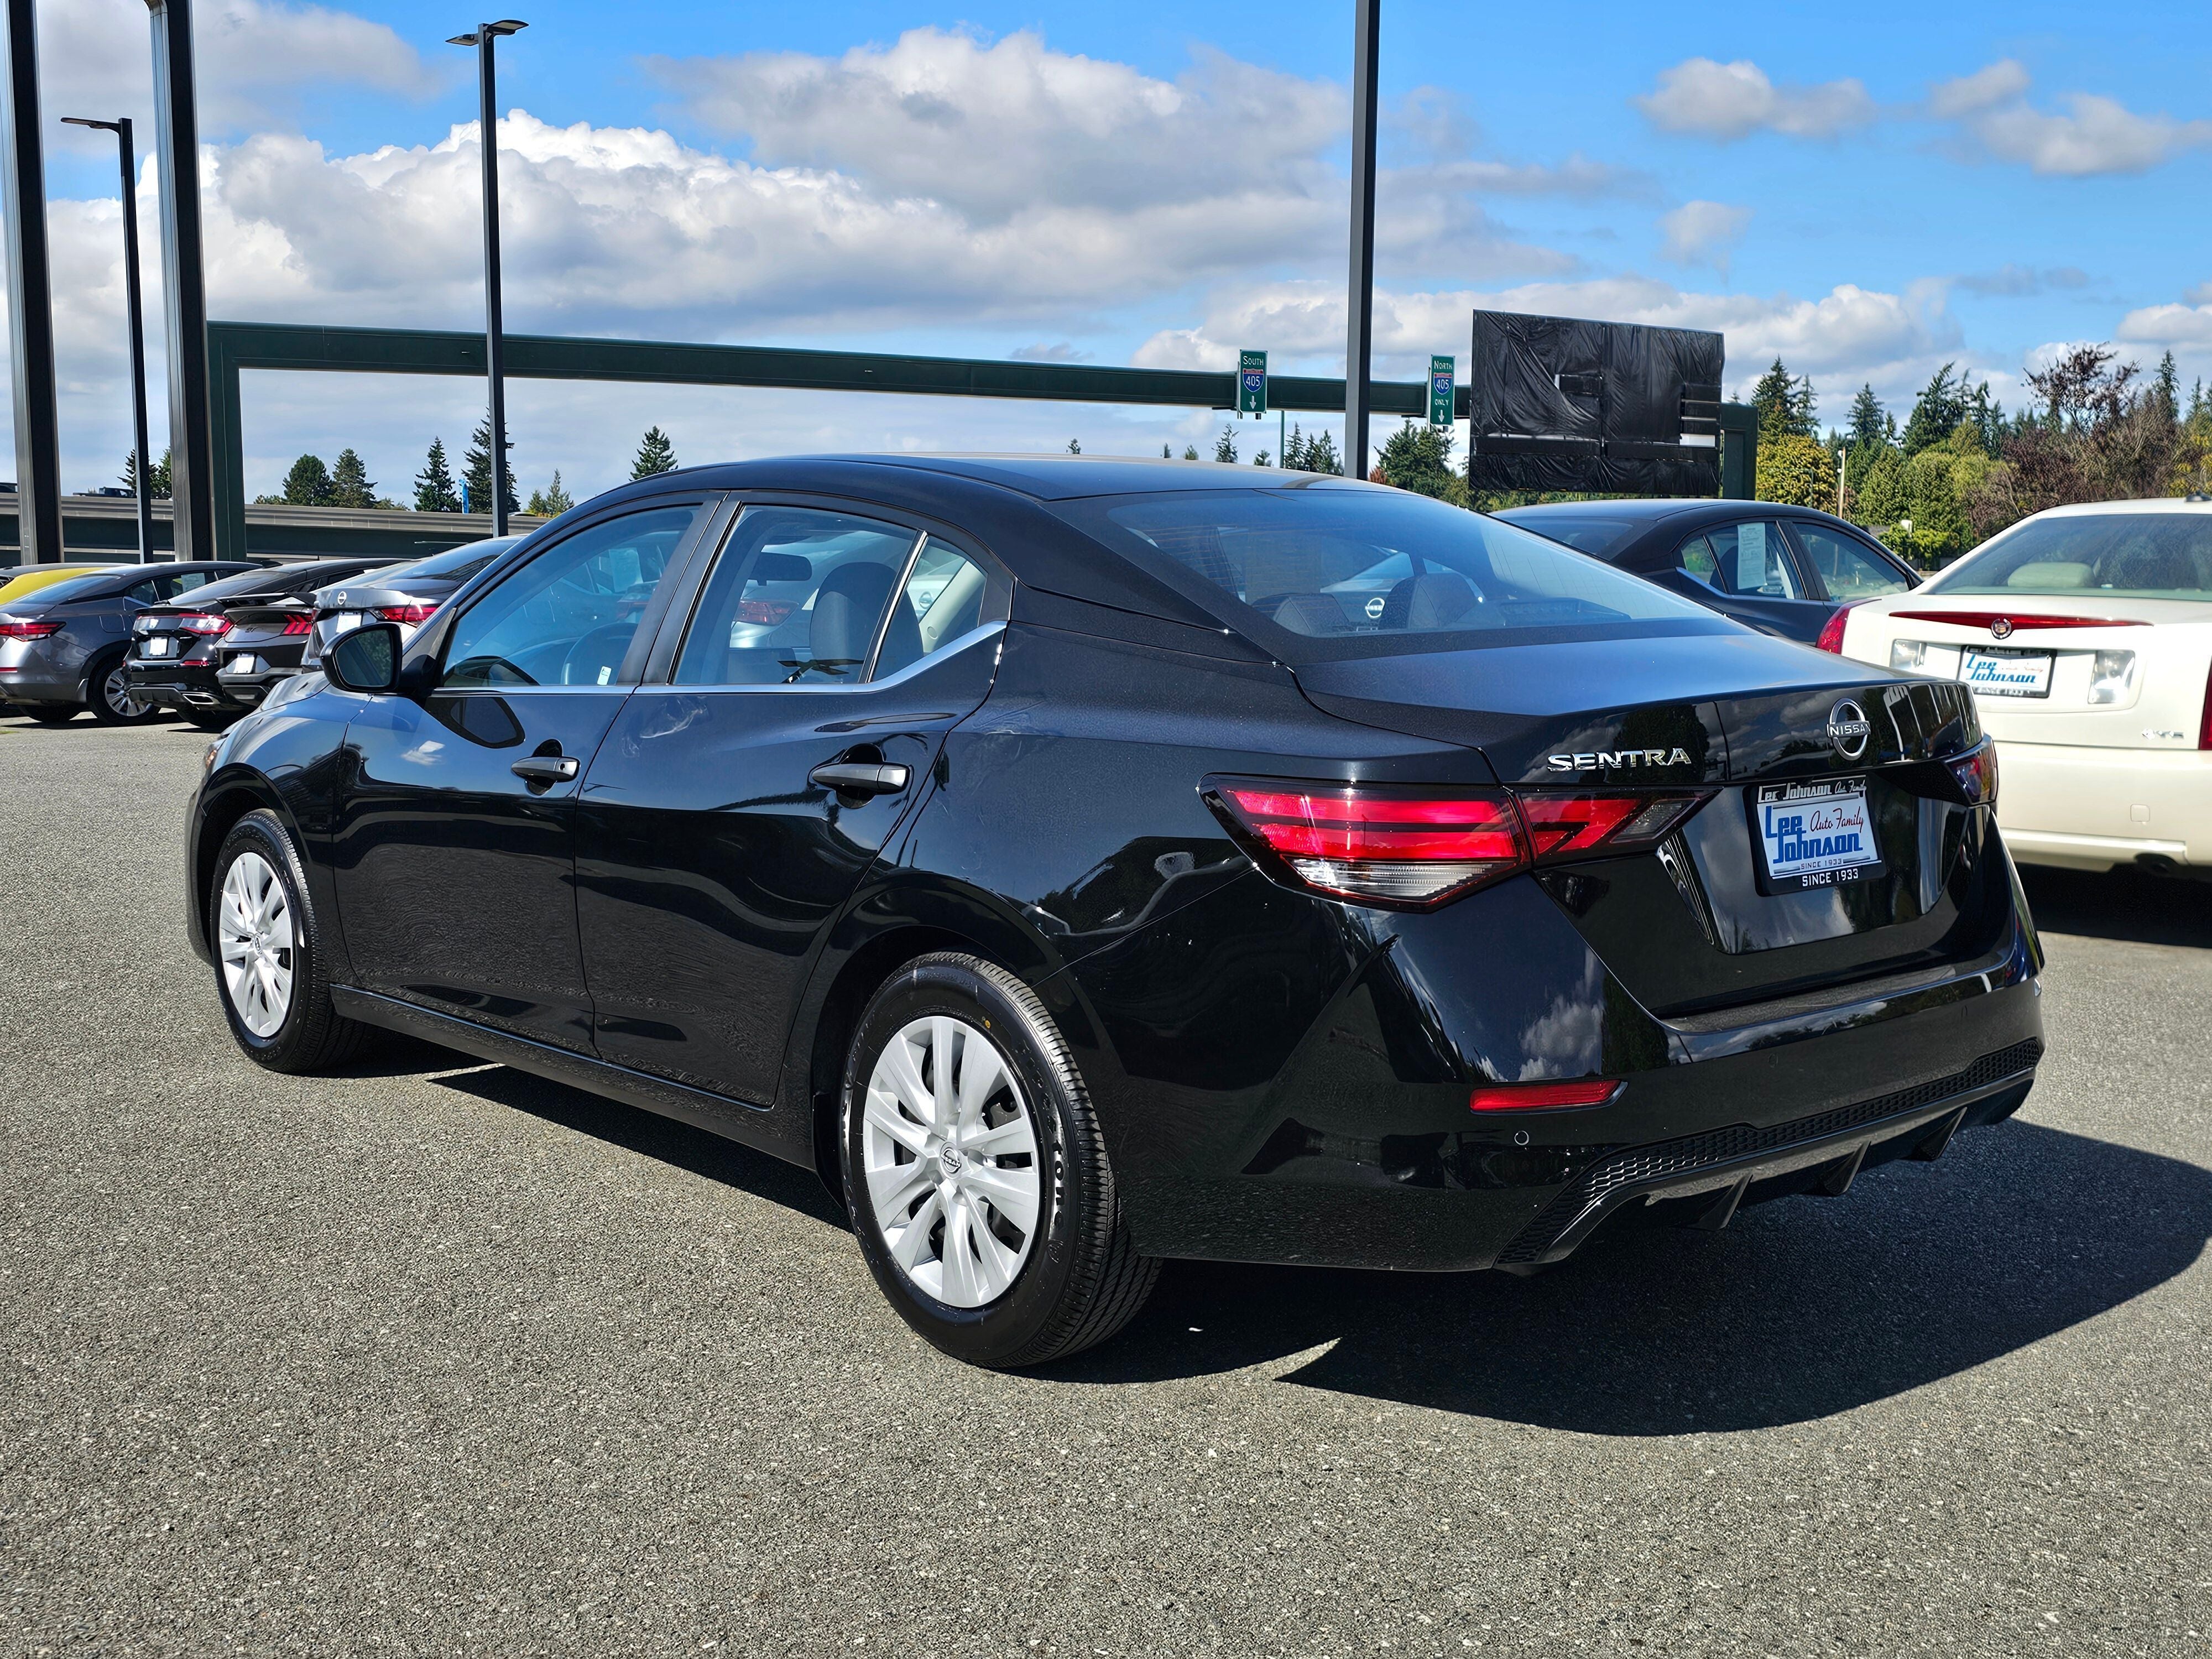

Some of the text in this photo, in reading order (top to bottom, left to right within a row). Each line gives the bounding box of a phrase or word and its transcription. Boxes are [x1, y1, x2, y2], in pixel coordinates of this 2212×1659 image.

[1243, 356, 1264, 366] SOUTH
[1434, 360, 1452, 369] NORTH
[1246, 376, 1260, 386] 405
[1436, 379, 1449, 389] 405
[1966, 654, 1997, 670] Lee
[1966, 666, 2036, 684] Johnson
[1547, 748, 1692, 772] SENTRA
[1757, 785, 1780, 803] Lee
[1783, 782, 1832, 800] Johnson
[1765, 805, 1864, 839] Lee Auto Family
[1772, 830, 1864, 864] Johnson
[1824, 858, 1843, 867] 1933
[1802, 868, 1859, 886] SINCE 1933
